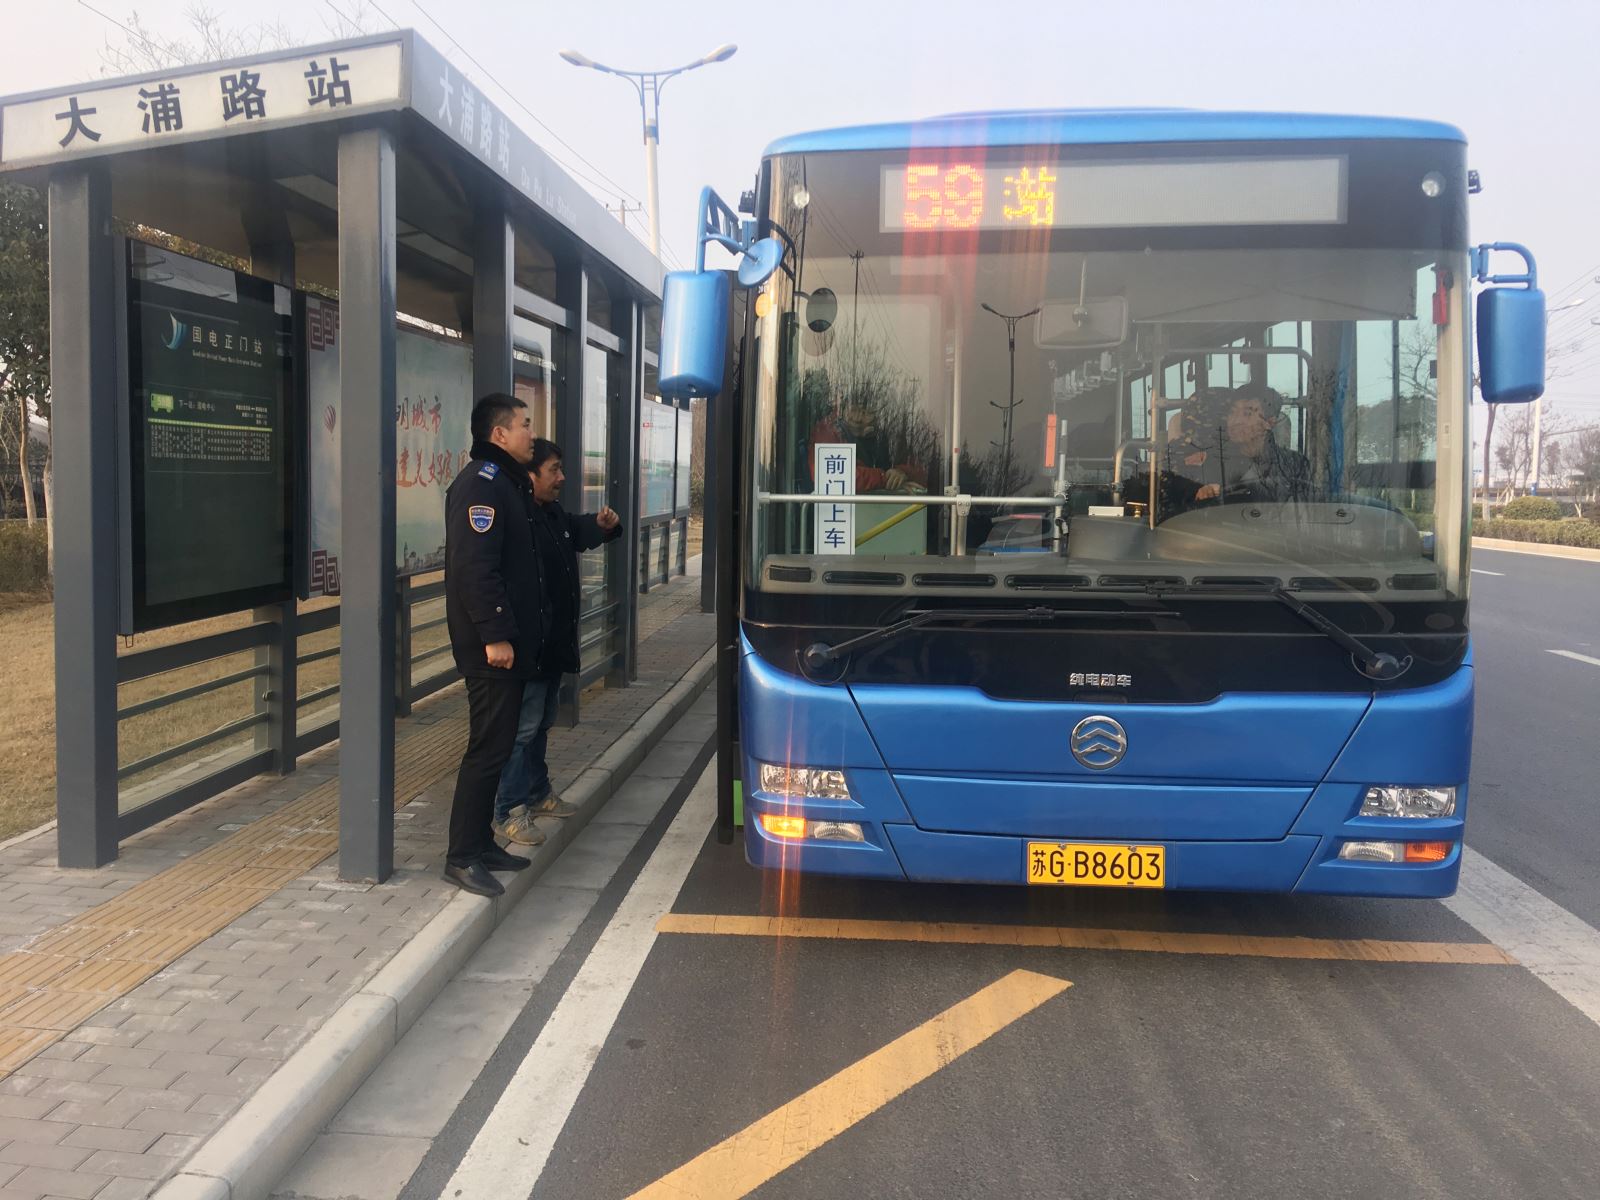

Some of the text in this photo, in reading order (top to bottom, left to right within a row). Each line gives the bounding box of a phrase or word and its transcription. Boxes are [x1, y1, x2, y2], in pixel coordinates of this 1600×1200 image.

[55, 57, 353, 148] 大浦路站
[438, 64, 510, 174] 大浦路站
[903, 164, 984, 228] 59
[192, 326, 263, 355] 国电正门站
[824, 454, 847, 549] 前门上车
[1069, 673, 1132, 687] 纯电动车
